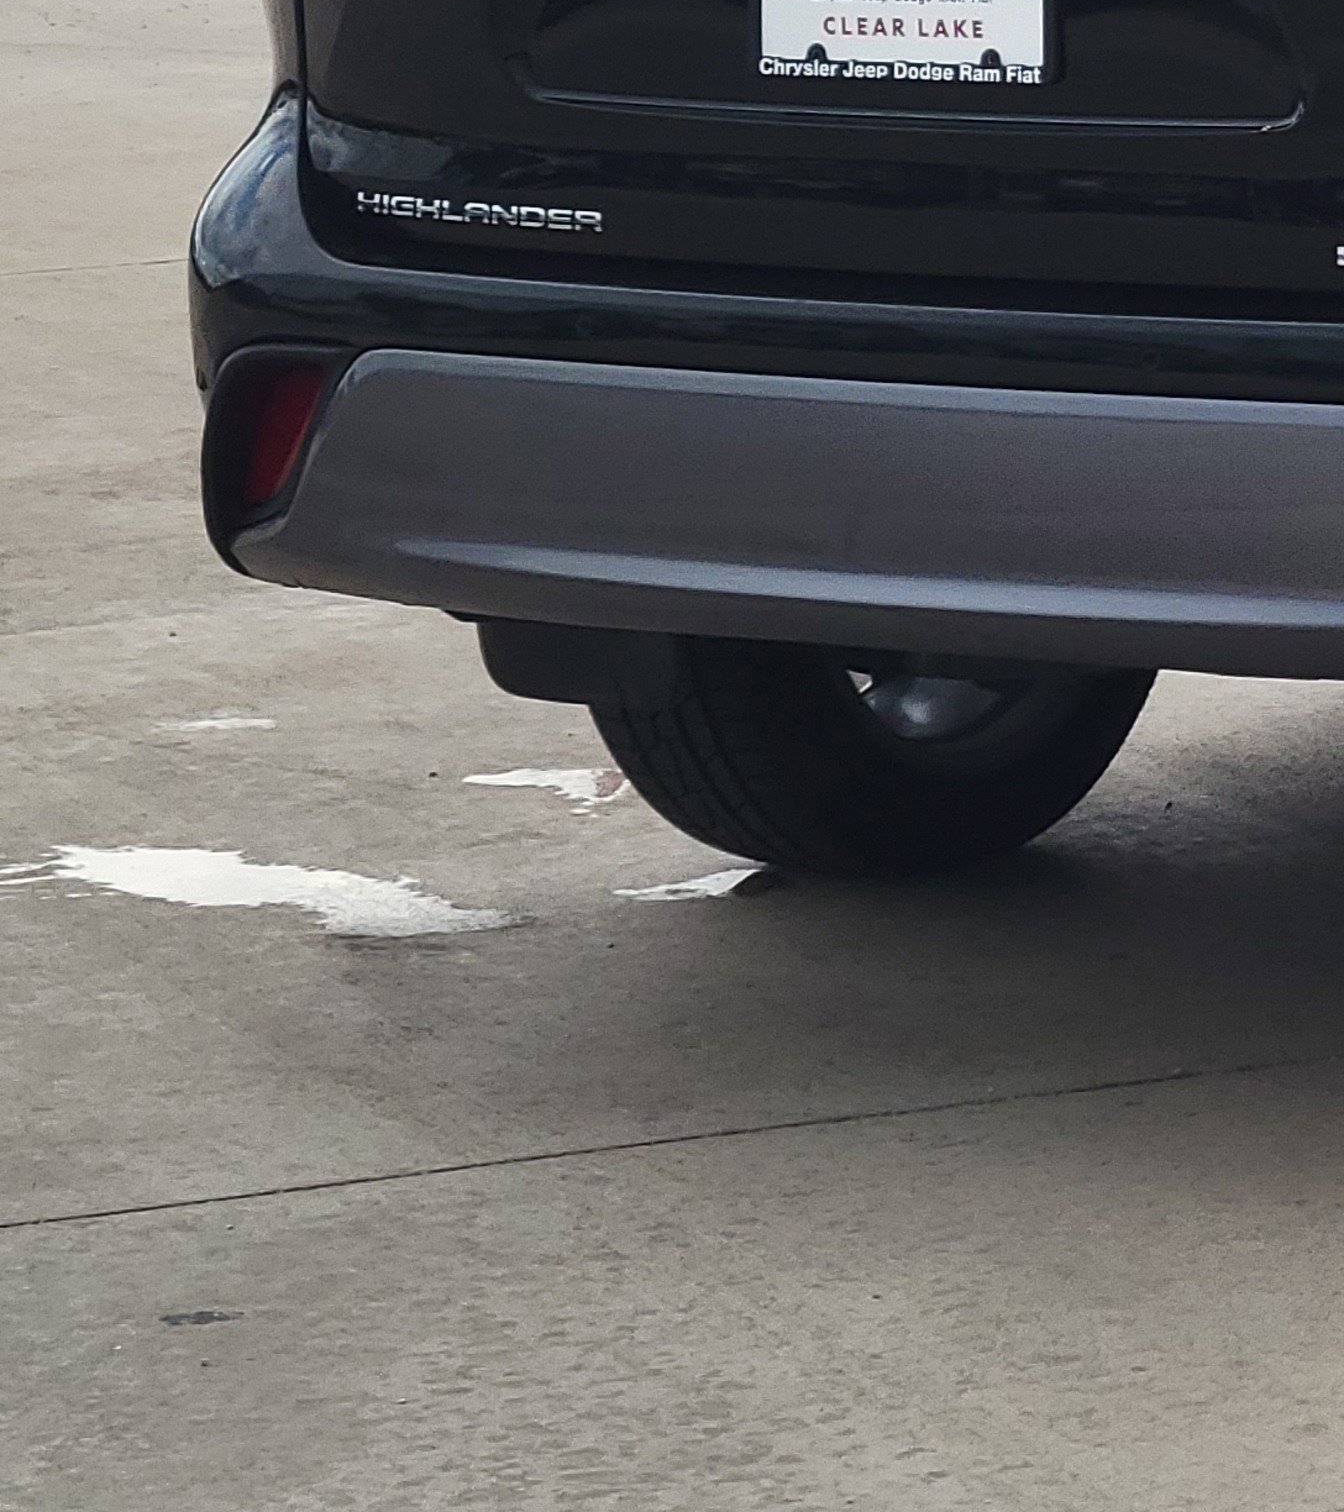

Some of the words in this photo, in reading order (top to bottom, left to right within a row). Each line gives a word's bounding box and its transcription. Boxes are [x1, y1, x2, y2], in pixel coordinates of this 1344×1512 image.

[823, 16, 905, 37] CLEAR
[918, 18, 984, 39] LAKE
[758, 57, 839, 78] Chrysler
[842, 61, 888, 80] Jeep
[893, 62, 954, 82] Dodge
[958, 65, 1000, 83] Ram
[1005, 66, 1042, 85] Fiat
[357, 191, 603, 232] HIGHLANDER
